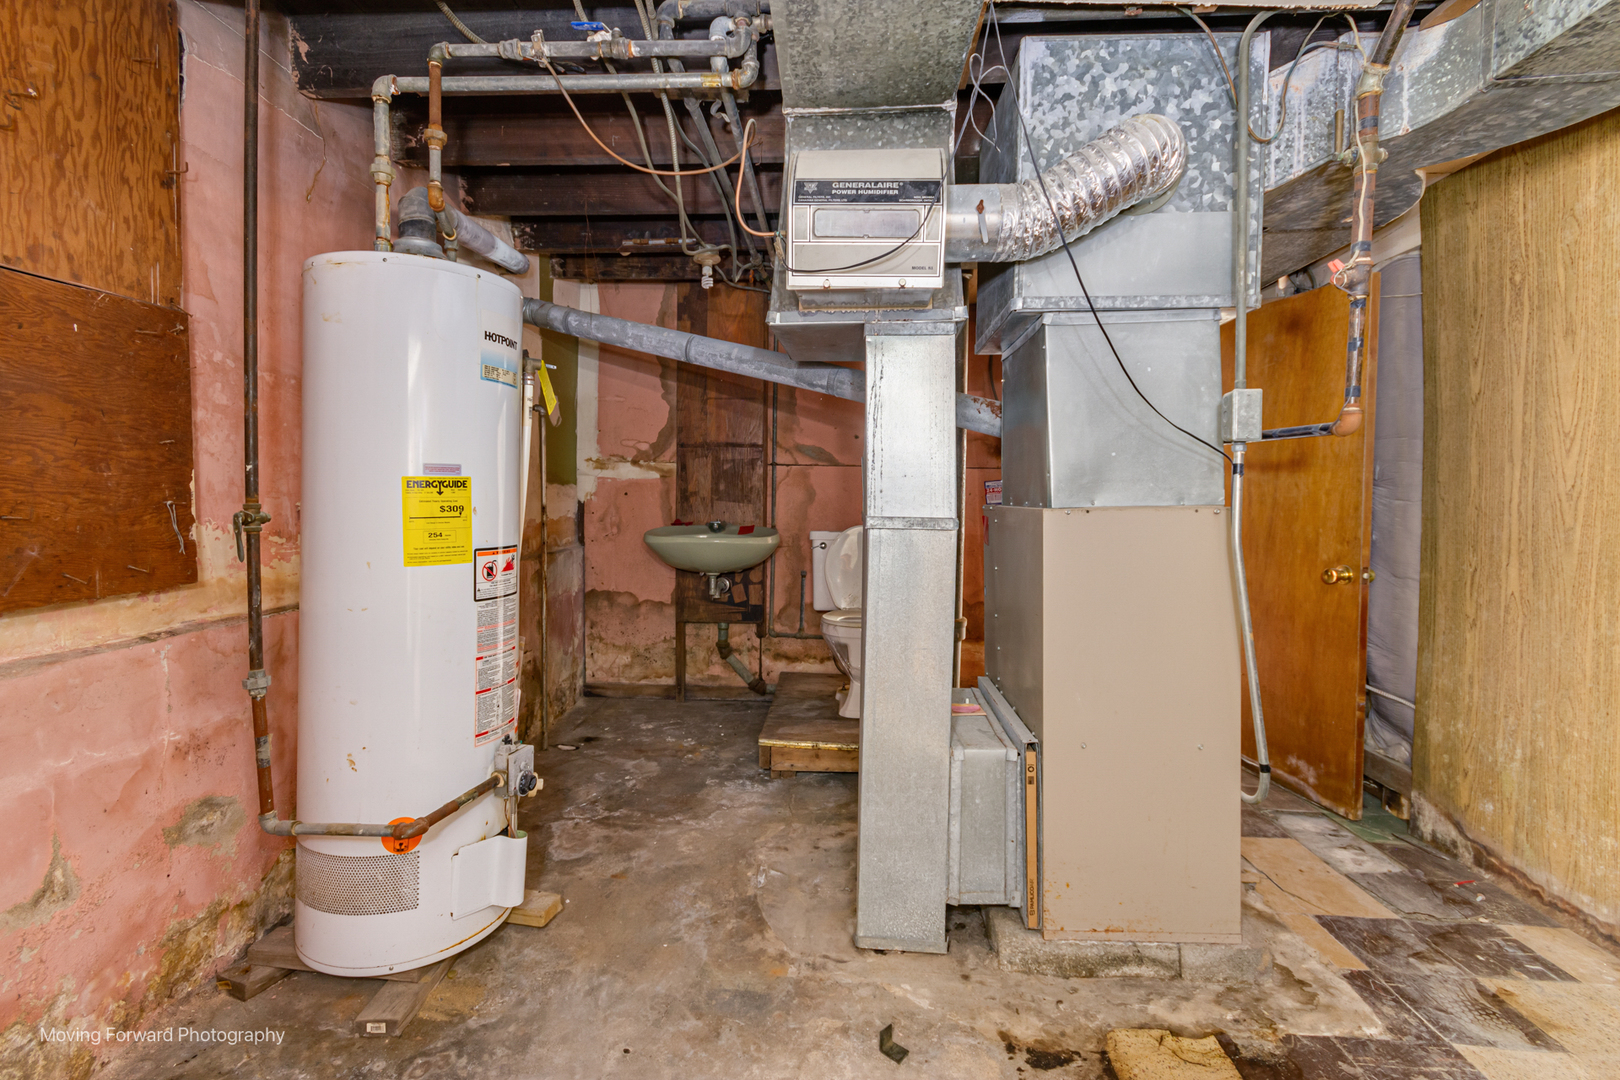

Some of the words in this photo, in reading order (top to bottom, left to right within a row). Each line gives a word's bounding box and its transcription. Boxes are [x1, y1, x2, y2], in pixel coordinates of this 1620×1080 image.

[484, 330, 518, 350] HOTPOINT
[406, 480, 468, 489] ENERGYGUIDE
[439, 505, 465, 513] $309
